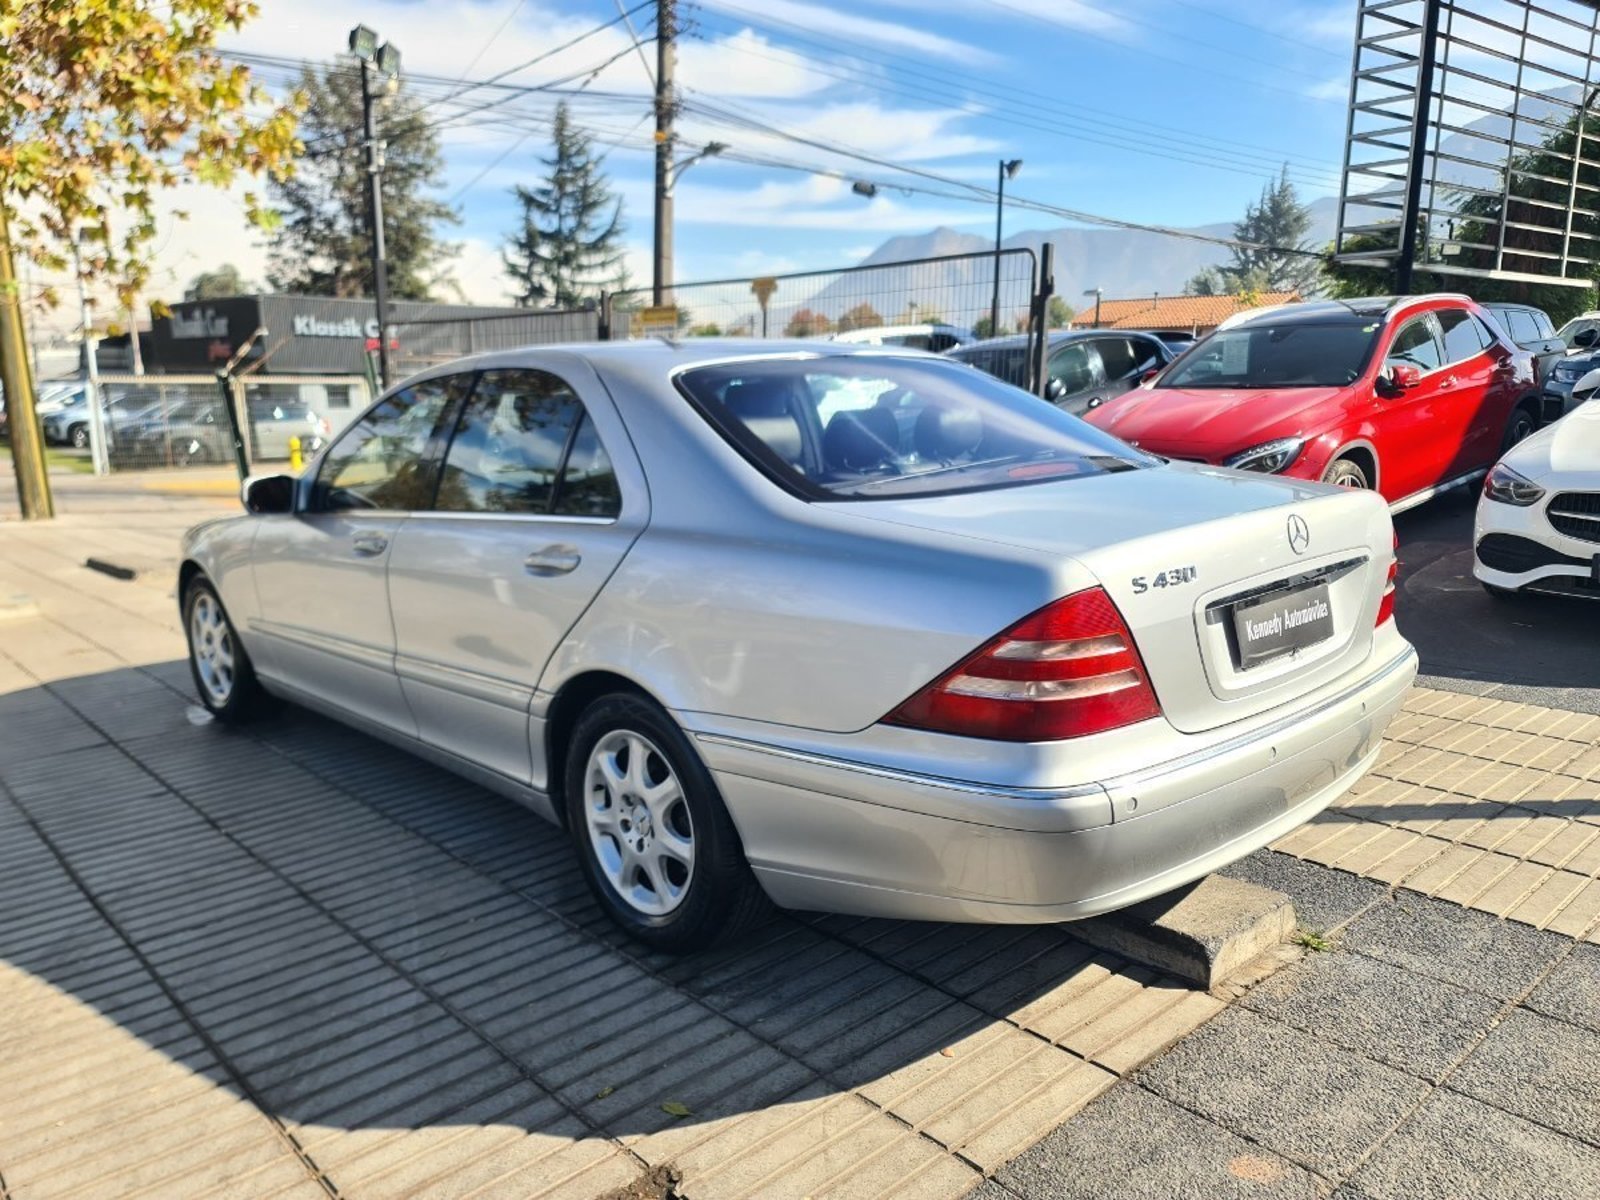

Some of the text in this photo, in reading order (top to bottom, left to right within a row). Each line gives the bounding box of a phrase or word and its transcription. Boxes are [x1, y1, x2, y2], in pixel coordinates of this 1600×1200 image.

[295, 315, 398, 339] Klassik Cr
[1131, 566, 1196, 594] S 430
[1246, 613, 1282, 642] Kennedy
